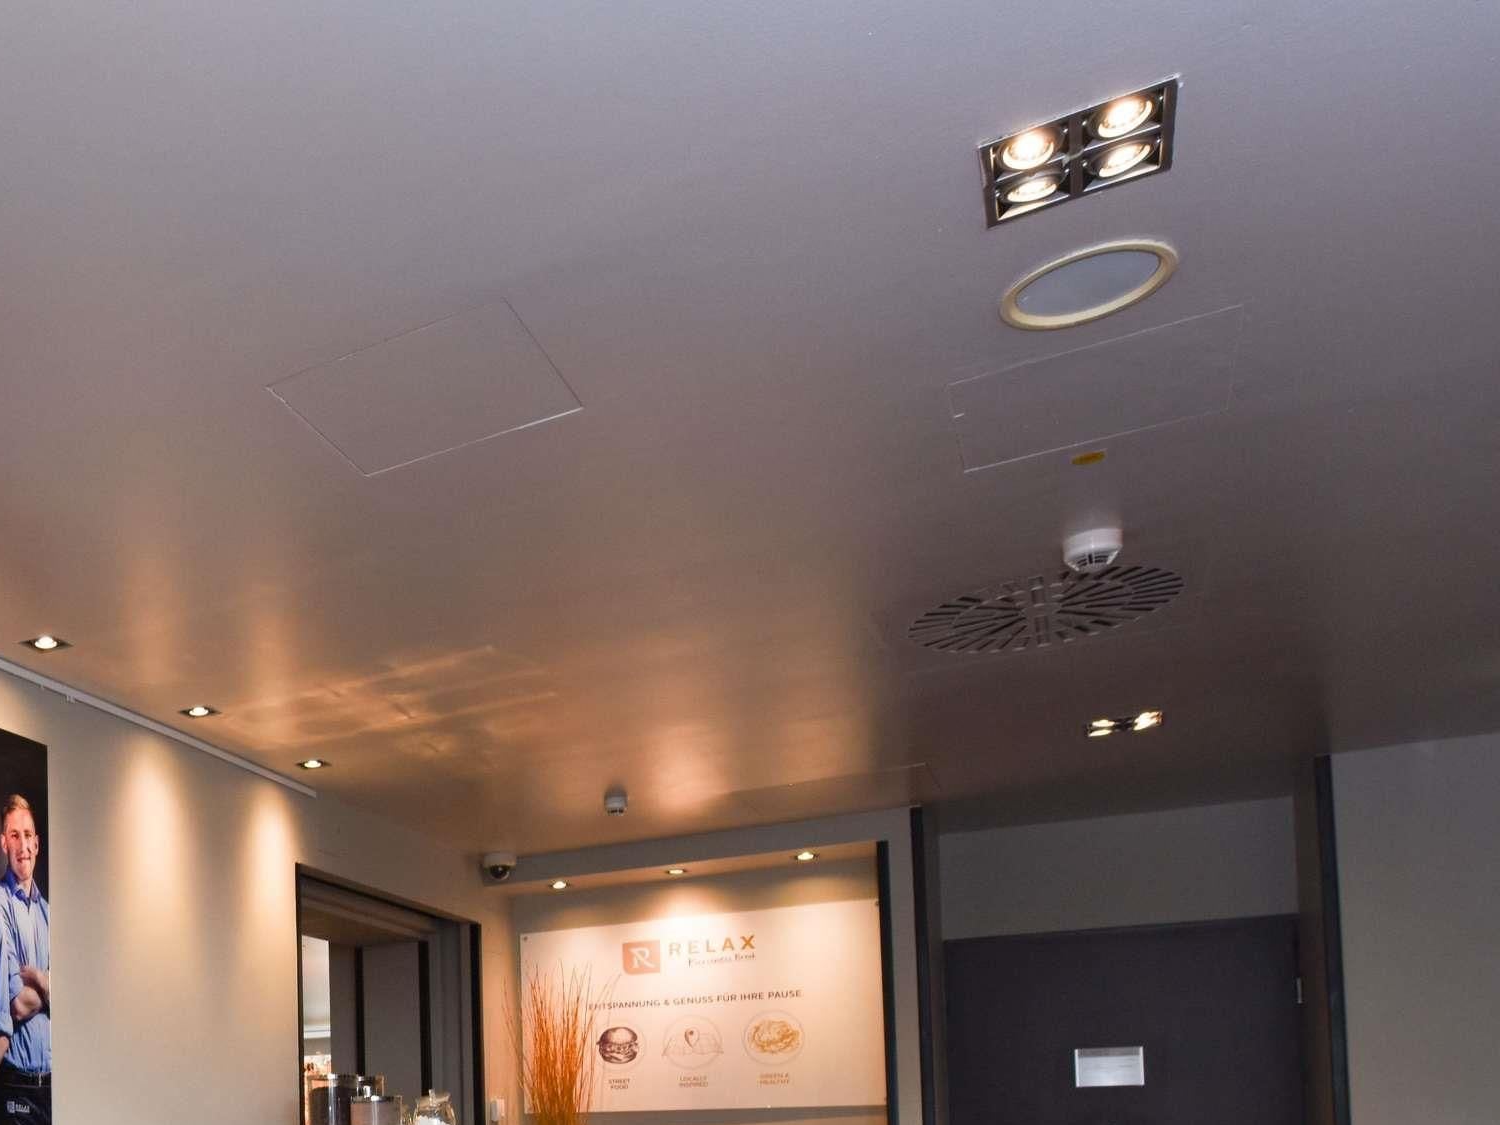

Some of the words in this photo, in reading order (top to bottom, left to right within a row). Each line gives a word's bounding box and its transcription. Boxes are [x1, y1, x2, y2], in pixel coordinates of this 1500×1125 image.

[668, 934, 756, 956] RELAX
[673, 994, 714, 1006] GENUSS
[716, 992, 737, 1003] FÜR
[740, 991, 765, 1001] IHRE
[768, 989, 801, 999] PAUSE
